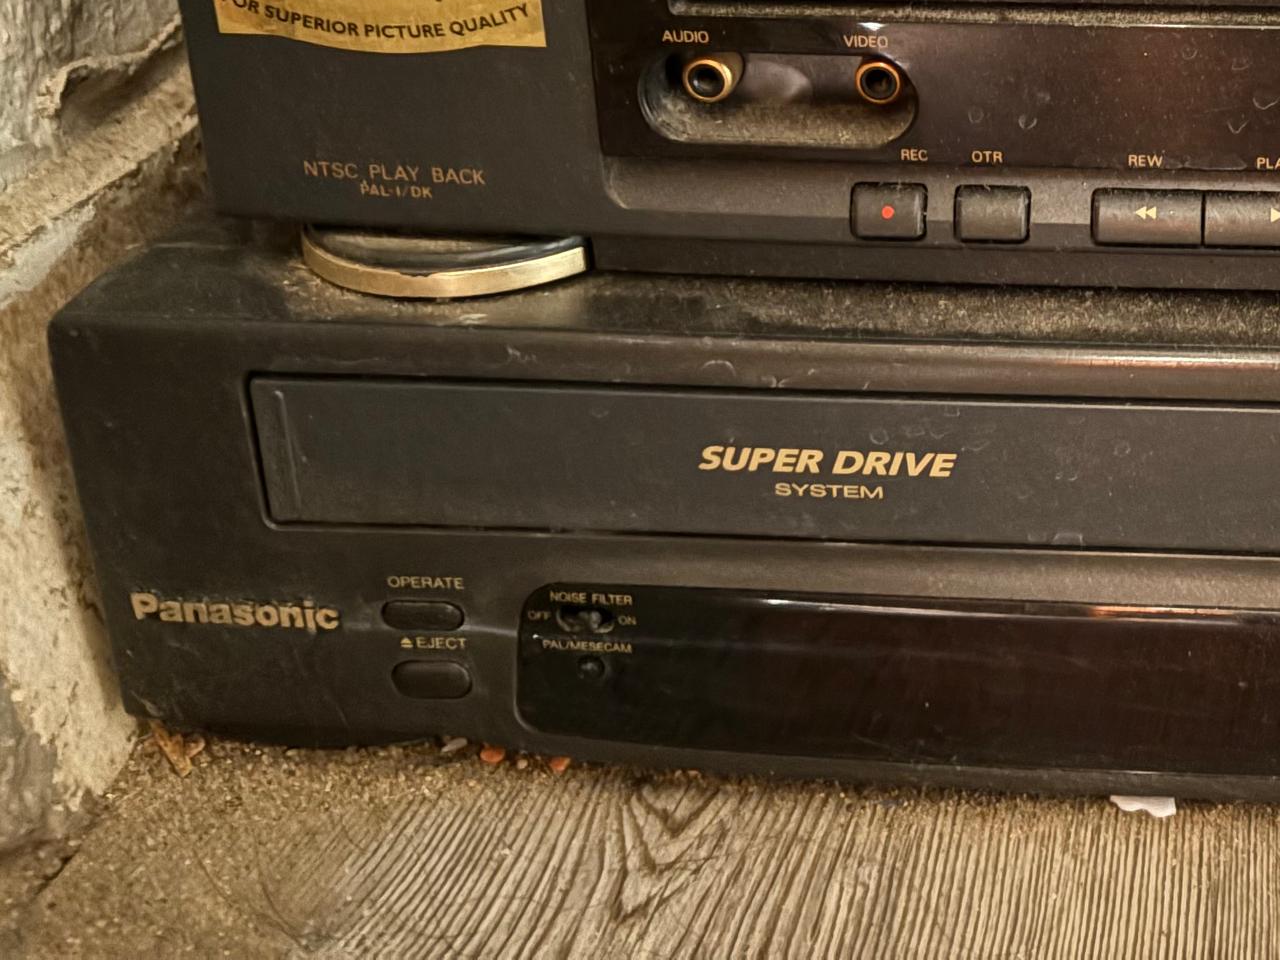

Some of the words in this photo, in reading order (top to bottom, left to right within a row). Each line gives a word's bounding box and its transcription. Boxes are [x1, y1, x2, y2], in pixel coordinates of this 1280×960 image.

[264, 4, 359, 37] SUPERIOR
[363, 24, 444, 40] PICTURE
[449, 2, 529, 37] QUALITY
[662, 29, 709, 44] AUDIO
[844, 35, 888, 49] VIDEO
[900, 148, 928, 162] REC
[971, 150, 1003, 164] OTR
[1128, 154, 1163, 168] REW
[303, 160, 358, 179] NTSC
[368, 164, 419, 182] PLAY
[431, 166, 486, 185] BACK
[698, 445, 824, 474] SUPER
[831, 450, 958, 477] DRIVE
[774, 482, 884, 499] SYSTEM
[387, 575, 464, 590] OPERATE
[550, 591, 587, 603] NOISE
[591, 593, 633, 606] FILTER
[130, 590, 340, 634] Panasonic
[528, 610, 550, 620] OFF
[618, 615, 637, 626] ON
[415, 636, 467, 650] EJECT
[542, 640, 633, 653] PAL/MESECAM
